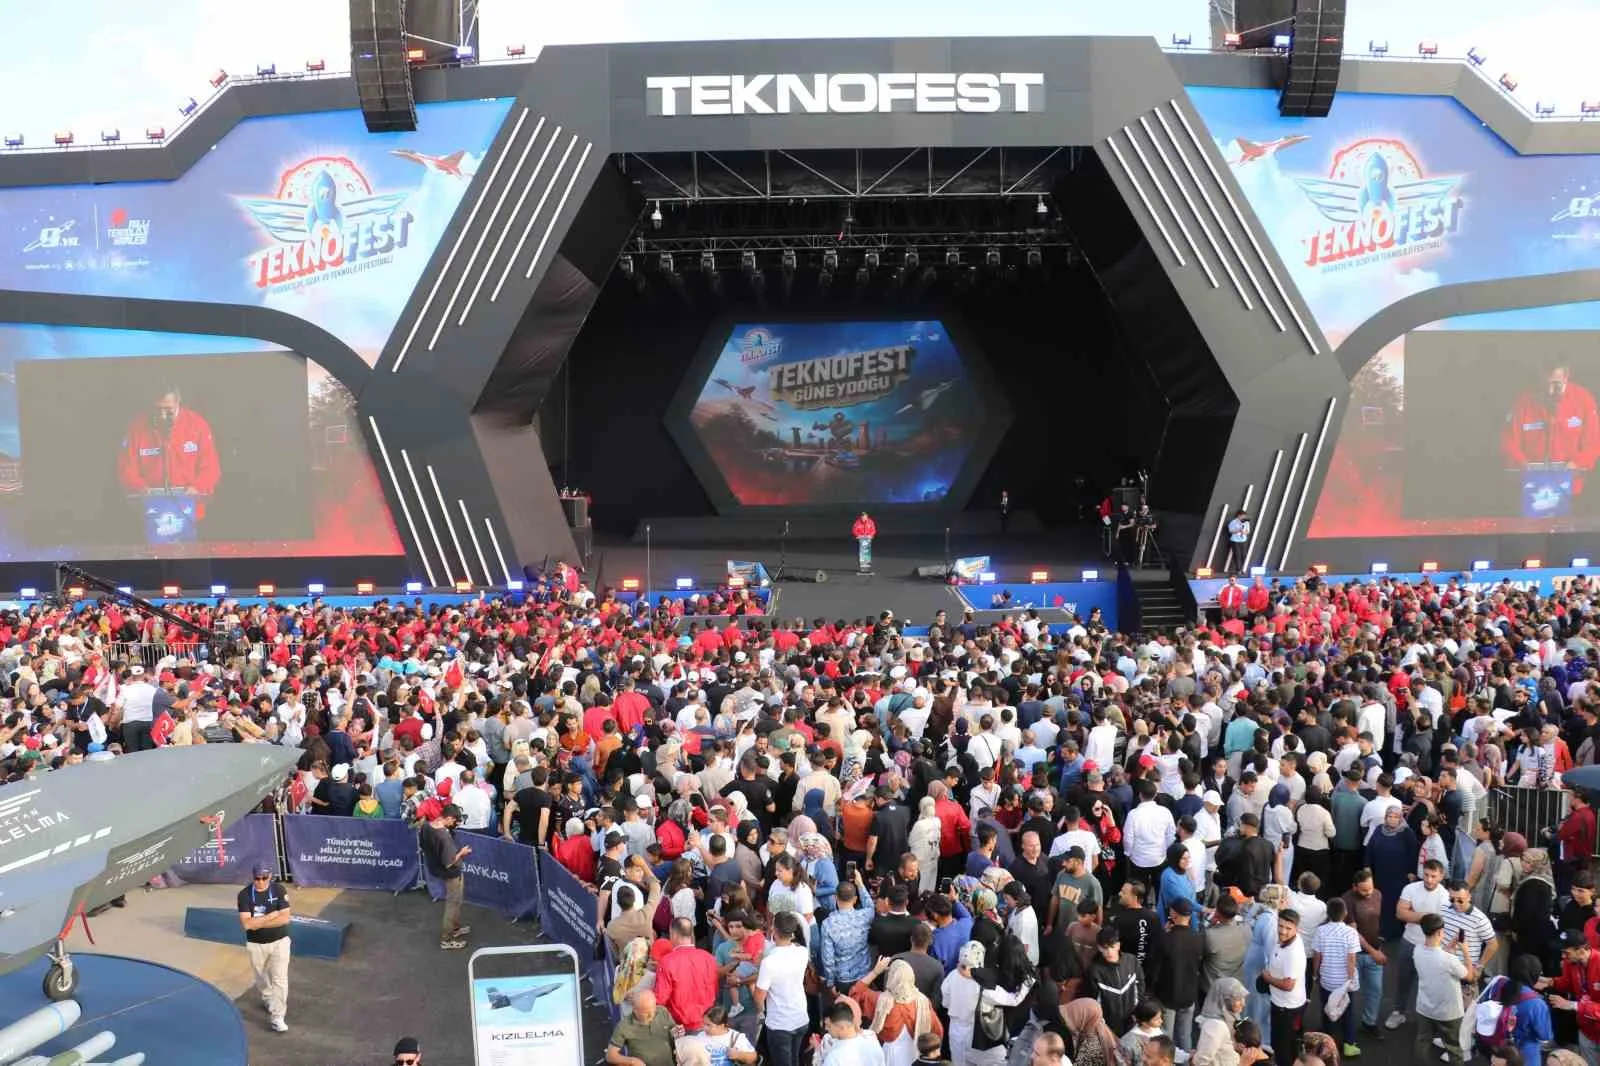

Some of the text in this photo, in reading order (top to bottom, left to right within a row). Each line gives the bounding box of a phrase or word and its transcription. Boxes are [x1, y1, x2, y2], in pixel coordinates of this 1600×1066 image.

[647, 72, 1044, 116] TEKNOFEST
[249, 211, 414, 288] TEKNOFEST
[1302, 197, 1464, 267] TEKNOFEST
[771, 345, 912, 390] TEKNOFEST
[793, 375, 890, 402] GÜNEYDOĞU
[178, 855, 237, 865] IZILELMA
[1138, 919, 1148, 951] Calvin
[491, 1029, 565, 1041] KIZILELMA
